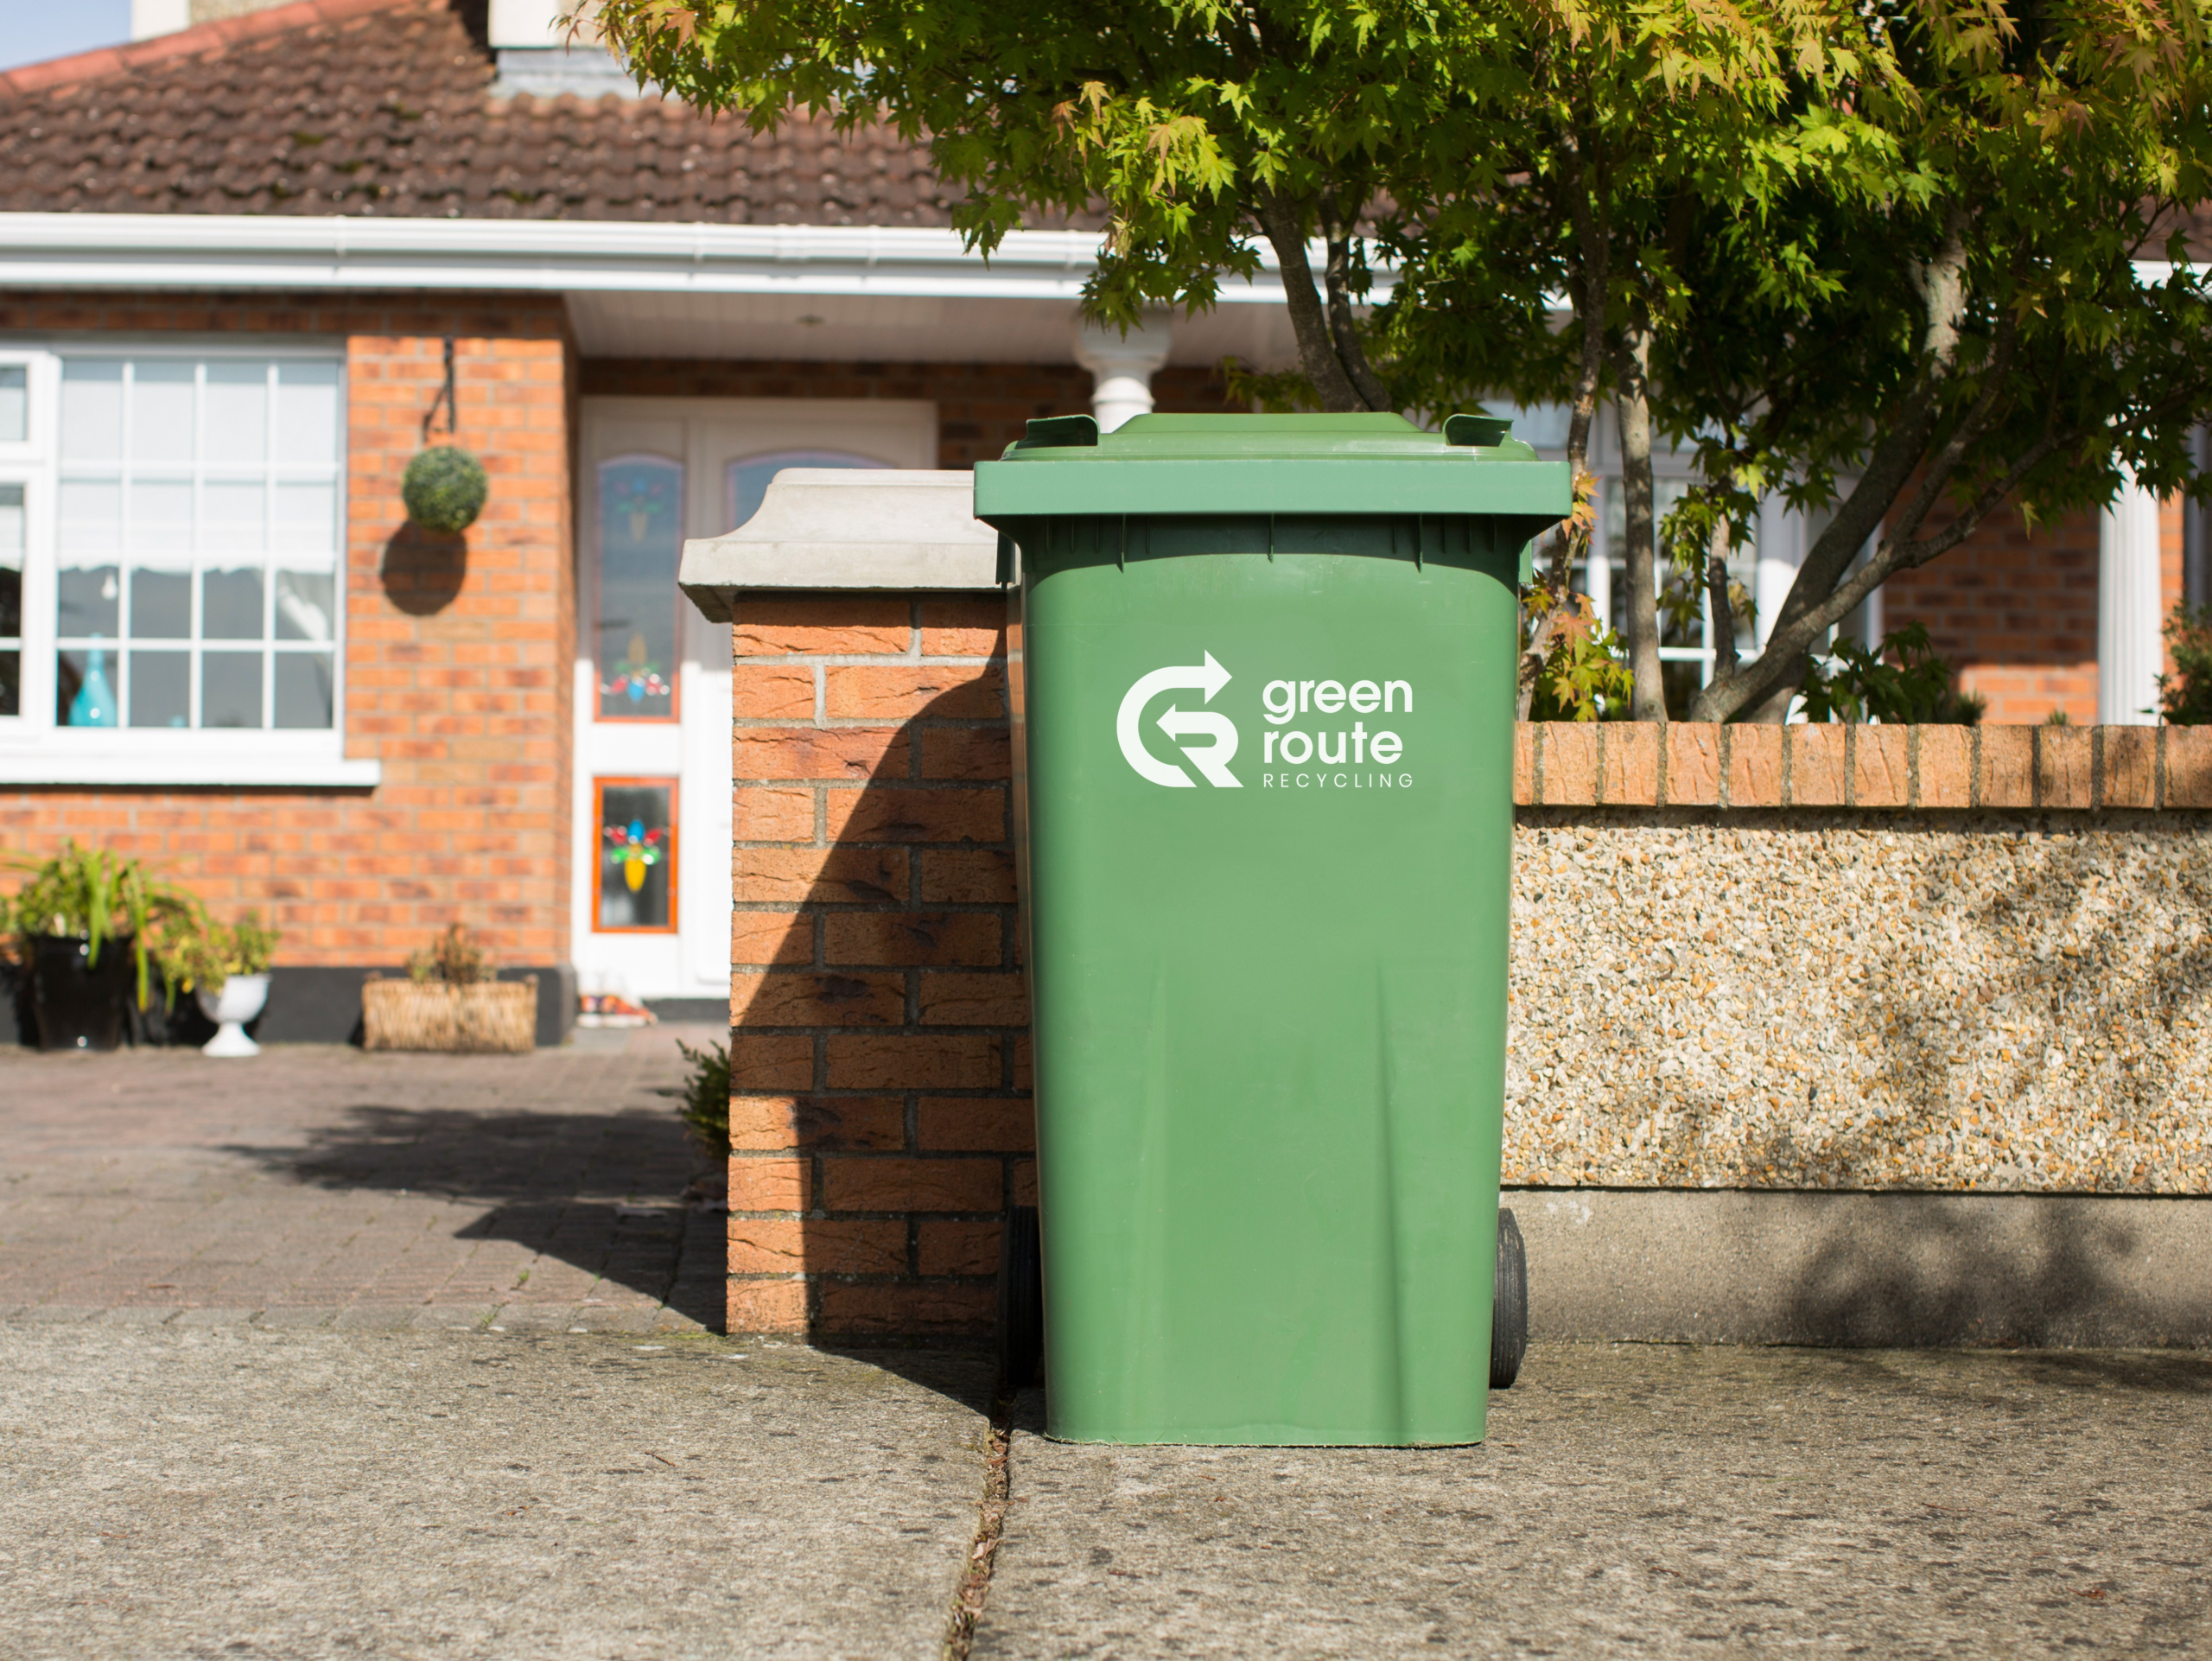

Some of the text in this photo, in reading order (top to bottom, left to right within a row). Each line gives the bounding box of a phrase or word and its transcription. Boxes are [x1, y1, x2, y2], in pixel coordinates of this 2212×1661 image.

[1262, 679, 1413, 725] green
[1264, 722, 1403, 765] route
[1263, 773, 1413, 788] RECYCLING
